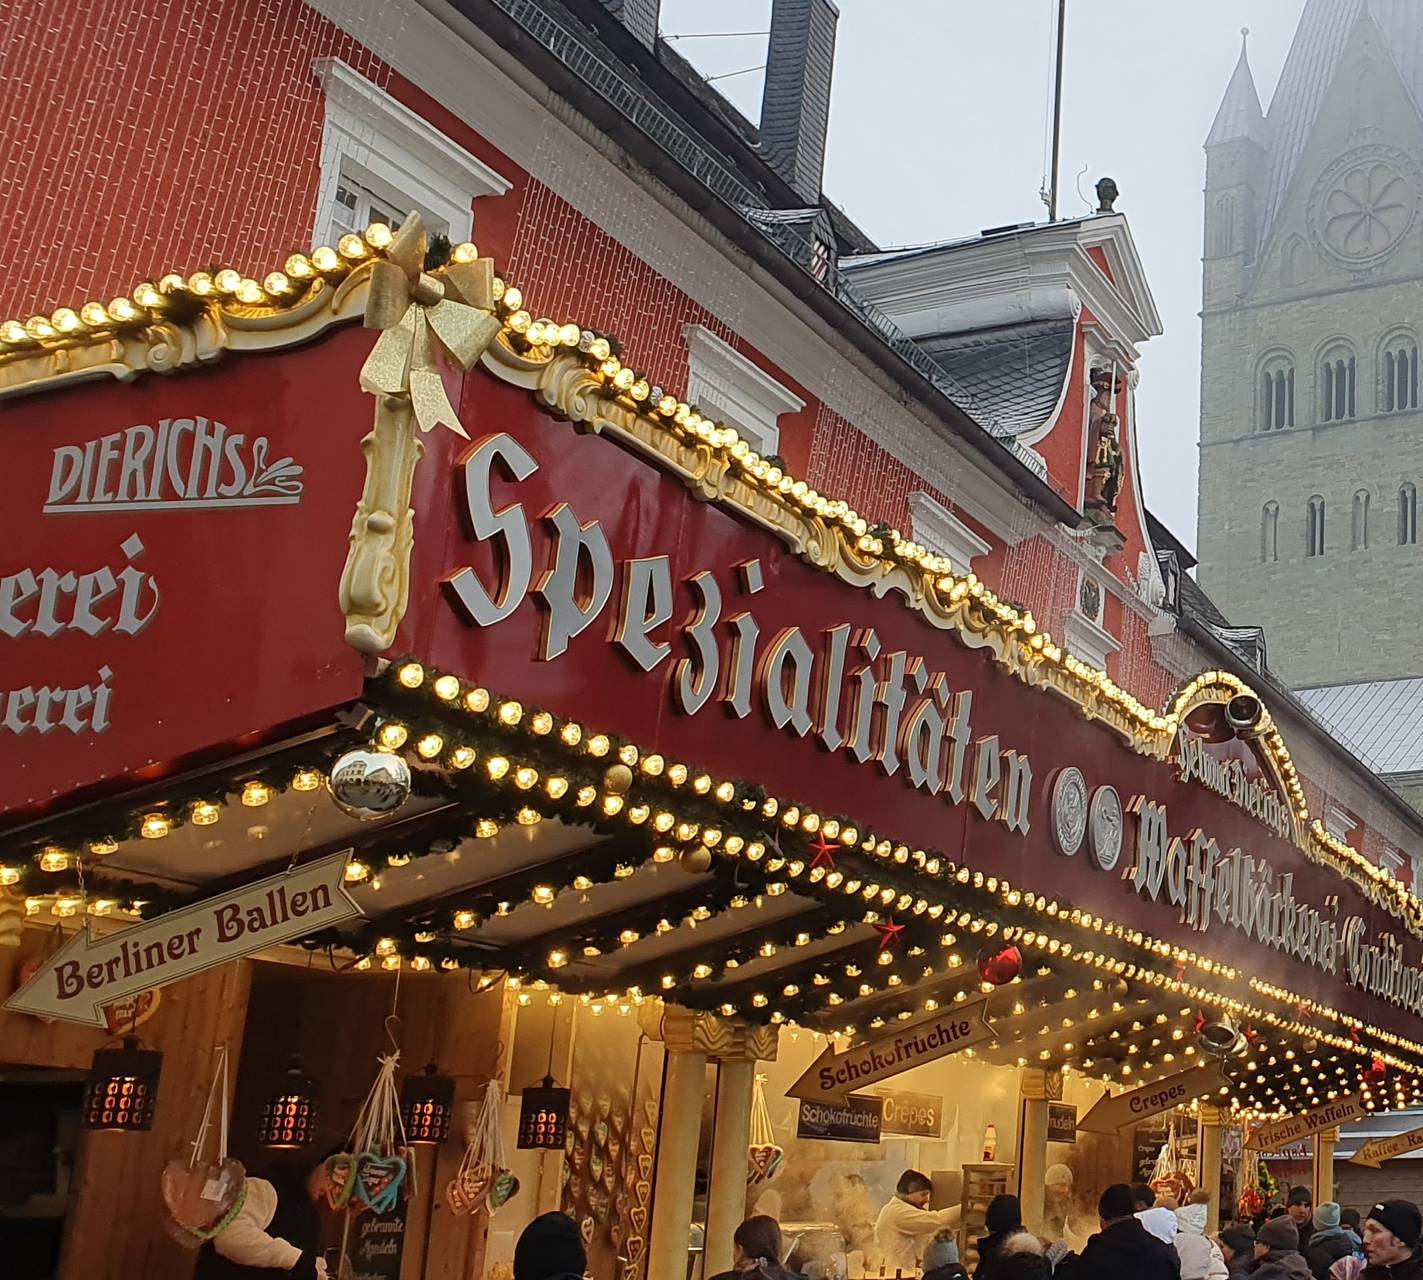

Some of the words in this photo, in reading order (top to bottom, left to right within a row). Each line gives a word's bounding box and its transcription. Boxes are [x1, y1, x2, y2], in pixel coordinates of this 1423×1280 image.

[46, 415, 246, 504] DIERICHS
[445, 432, 1034, 836] Spezialitäten
[53, 926, 202, 1000] Berliner
[214, 883, 332, 943] Ballen
[819, 1020, 971, 1091] Schokofrüchte
[1129, 1084, 1186, 1113] Crepes
[1303, 1103, 1355, 1131] Waffeln
